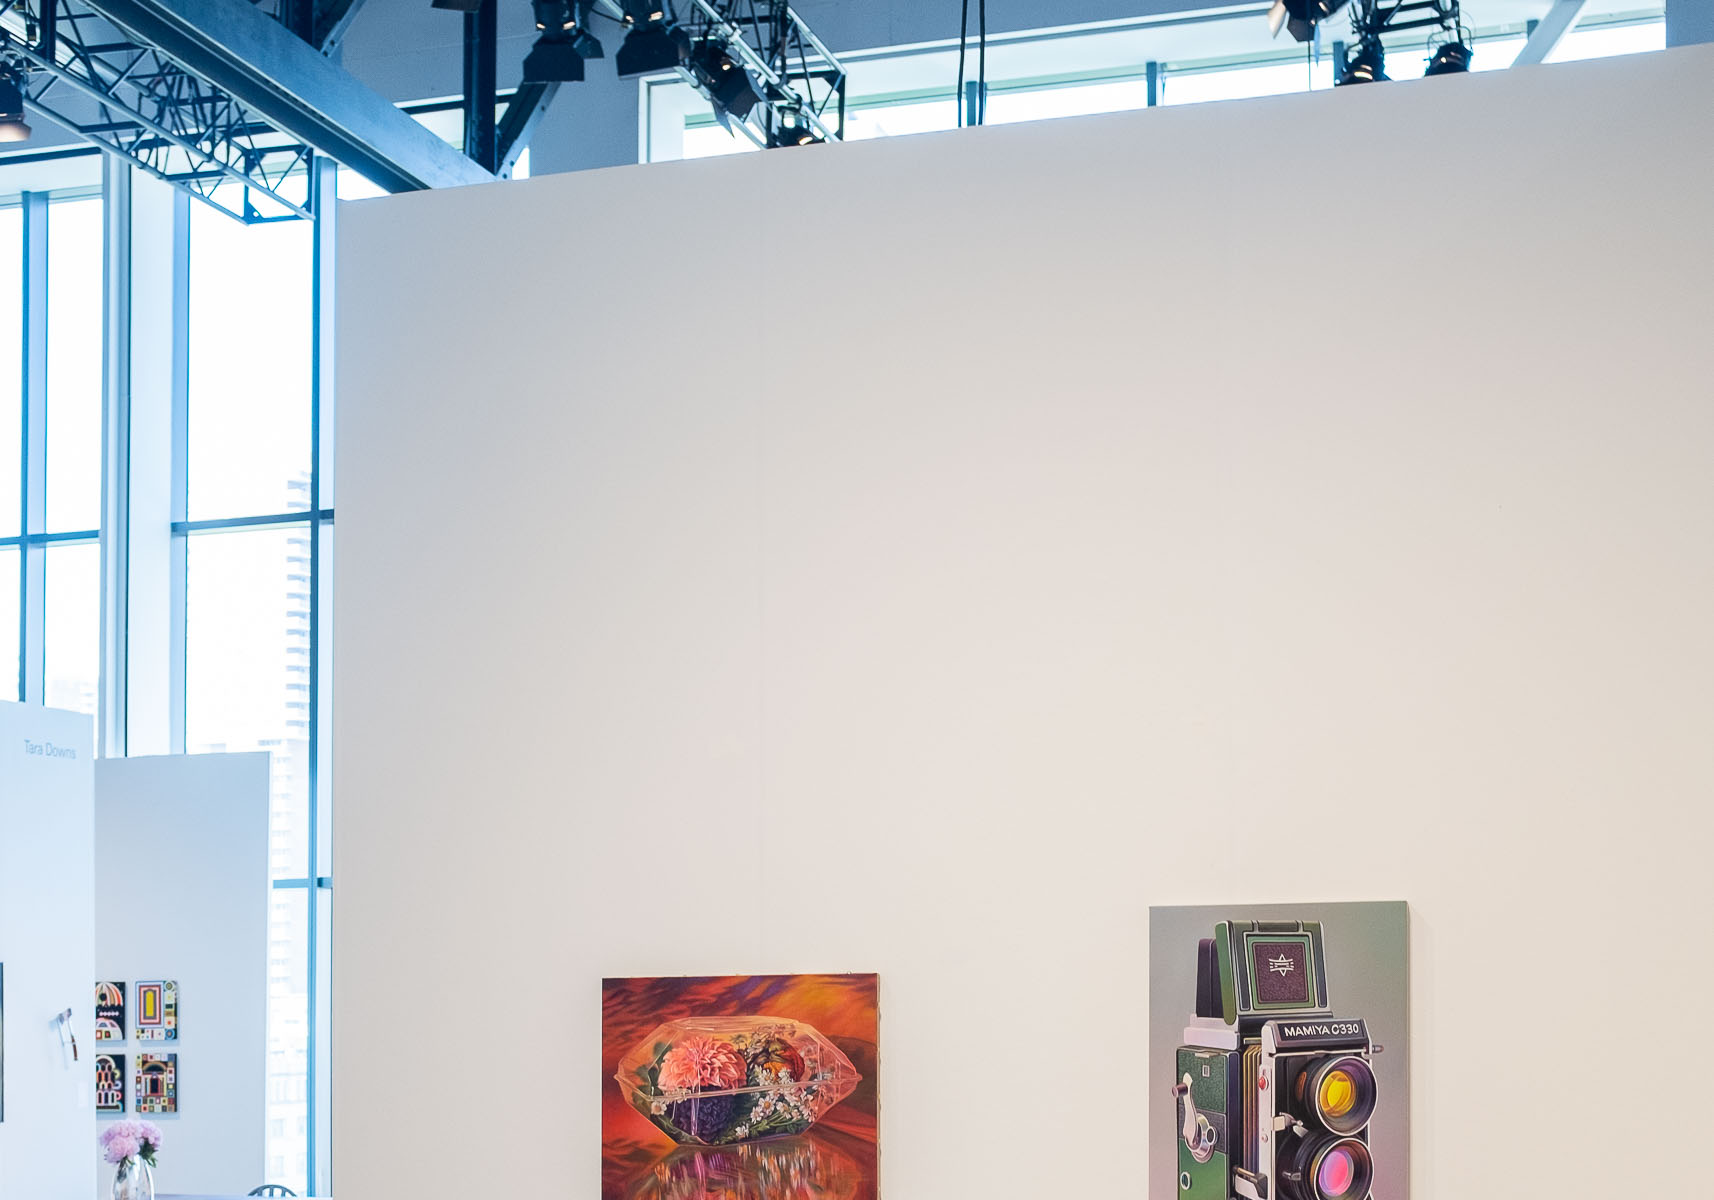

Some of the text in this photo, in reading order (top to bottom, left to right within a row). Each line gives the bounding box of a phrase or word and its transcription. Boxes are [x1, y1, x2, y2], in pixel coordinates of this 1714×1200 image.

[24, 739, 77, 760] Tara Downs
[1284, 1024, 1359, 1037] MAMIYA C330
